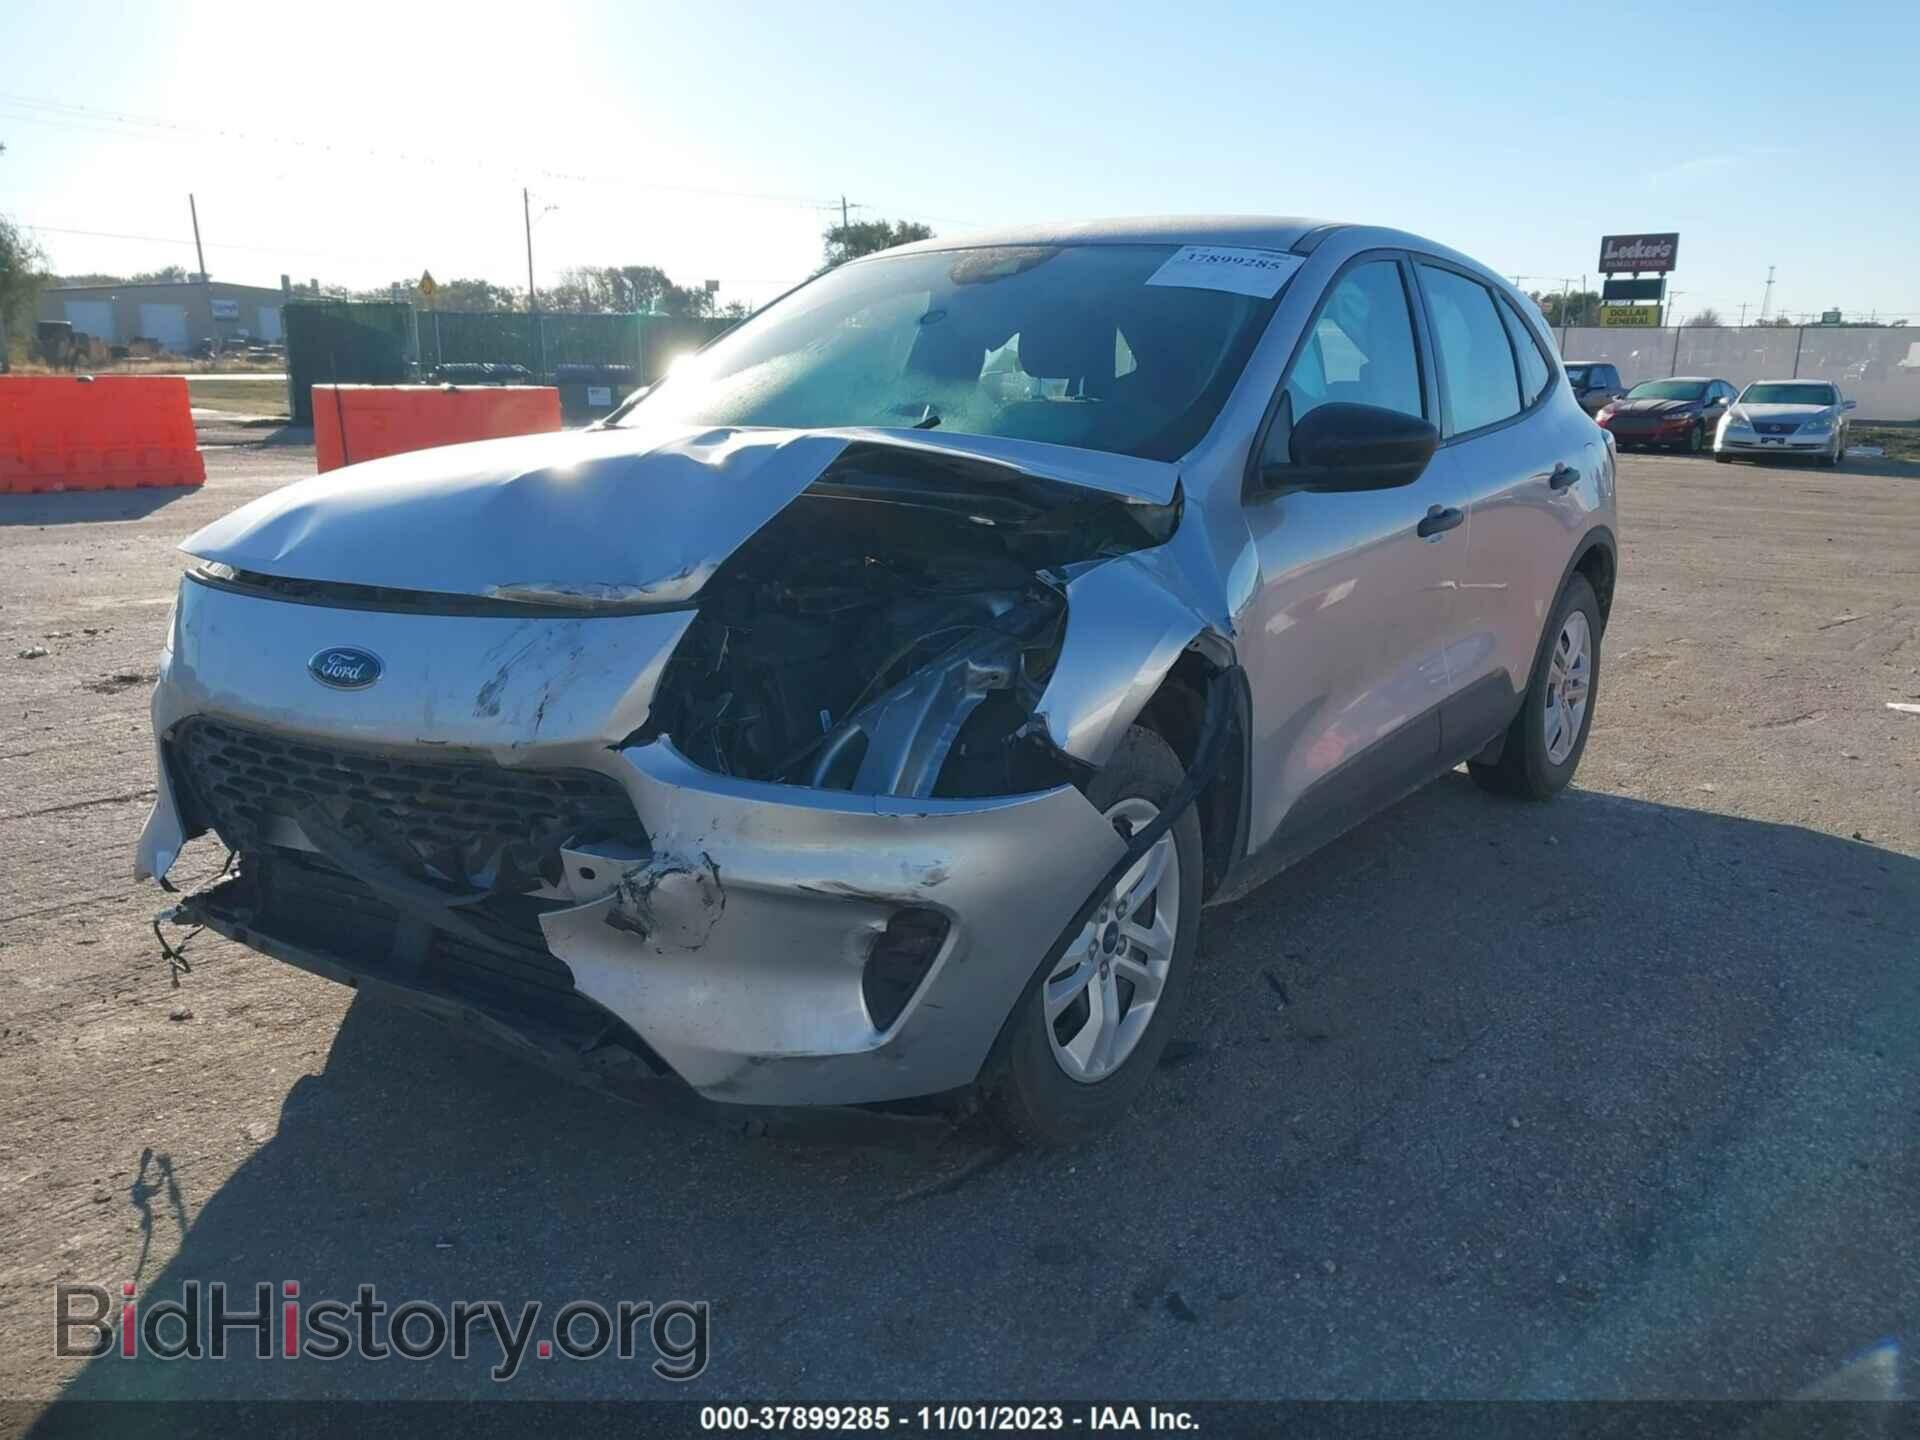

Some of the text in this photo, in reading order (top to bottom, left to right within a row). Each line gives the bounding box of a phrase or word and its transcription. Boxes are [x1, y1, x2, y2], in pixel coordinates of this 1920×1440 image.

[1610, 309, 1648, 317] DOLLAR
[1606, 317, 1648, 325] GENERAL
[322, 653, 365, 680] Ford
